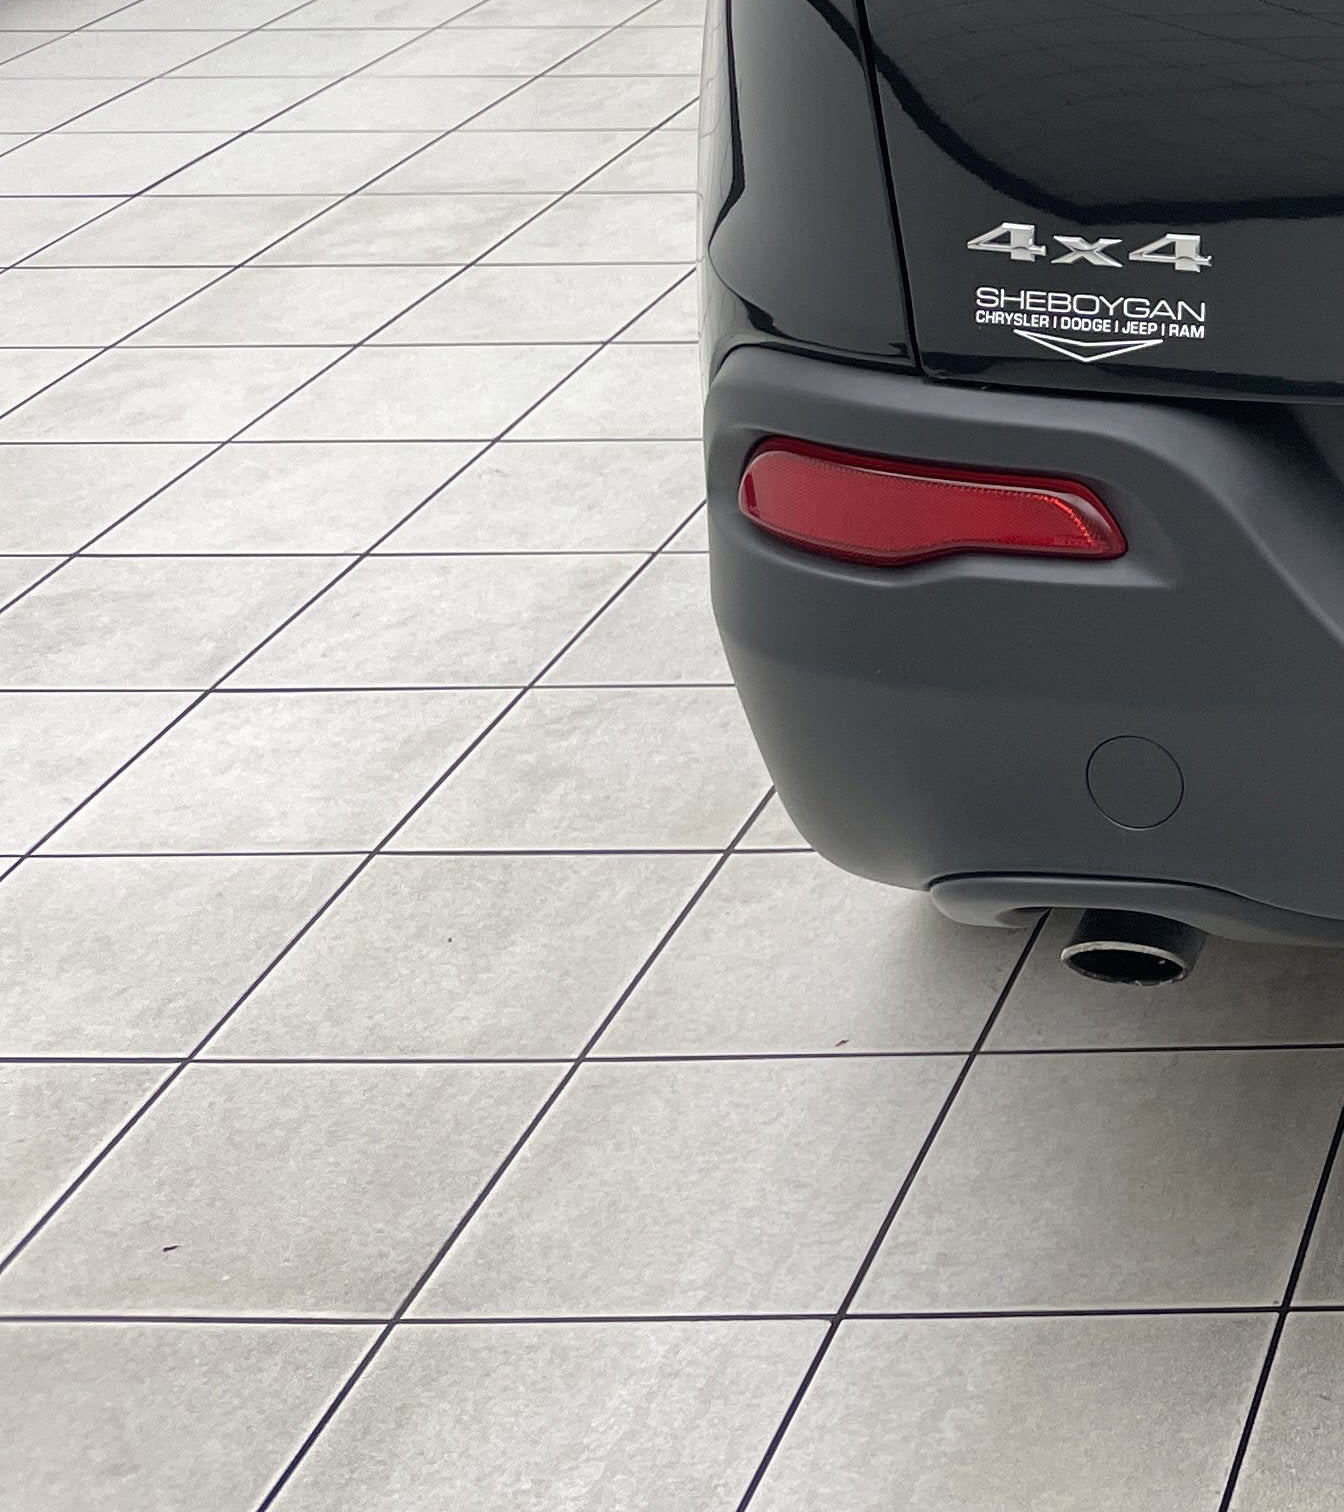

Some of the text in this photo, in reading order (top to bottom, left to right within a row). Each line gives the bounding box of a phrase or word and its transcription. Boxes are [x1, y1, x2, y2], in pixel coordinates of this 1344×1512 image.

[966, 221, 1213, 273] 4x4
[975, 286, 1206, 322] SHEBOYGAN
[975, 310, 1206, 339] CHRYSLER DODGE JEEP RAM
